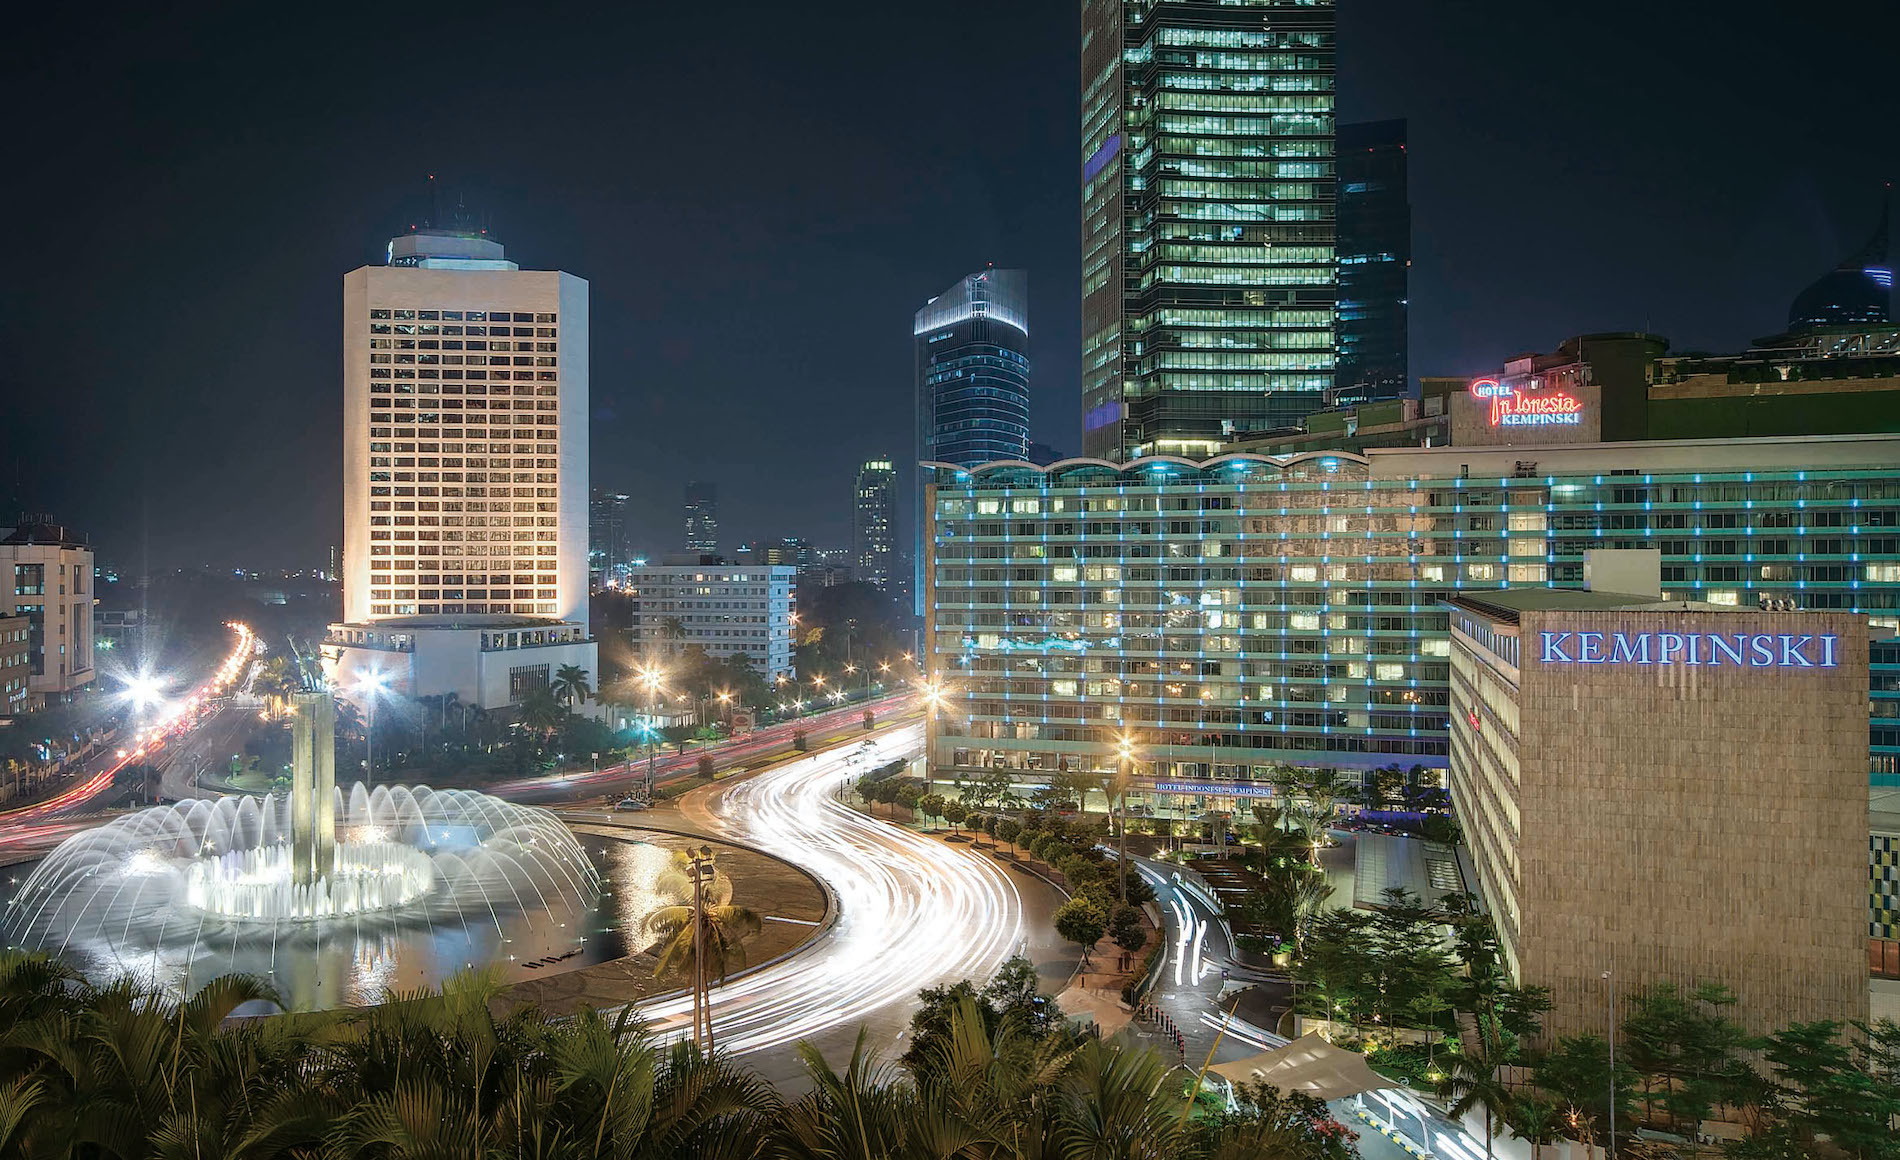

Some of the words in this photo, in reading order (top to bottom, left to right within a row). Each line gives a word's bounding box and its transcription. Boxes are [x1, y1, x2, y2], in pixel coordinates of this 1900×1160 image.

[1478, 386, 1514, 396] HOTEL
[1502, 413, 1579, 425] KEMPINSKI
[1540, 631, 1838, 667] KEMPINSKI
[1156, 783, 1181, 791] HOTEL
